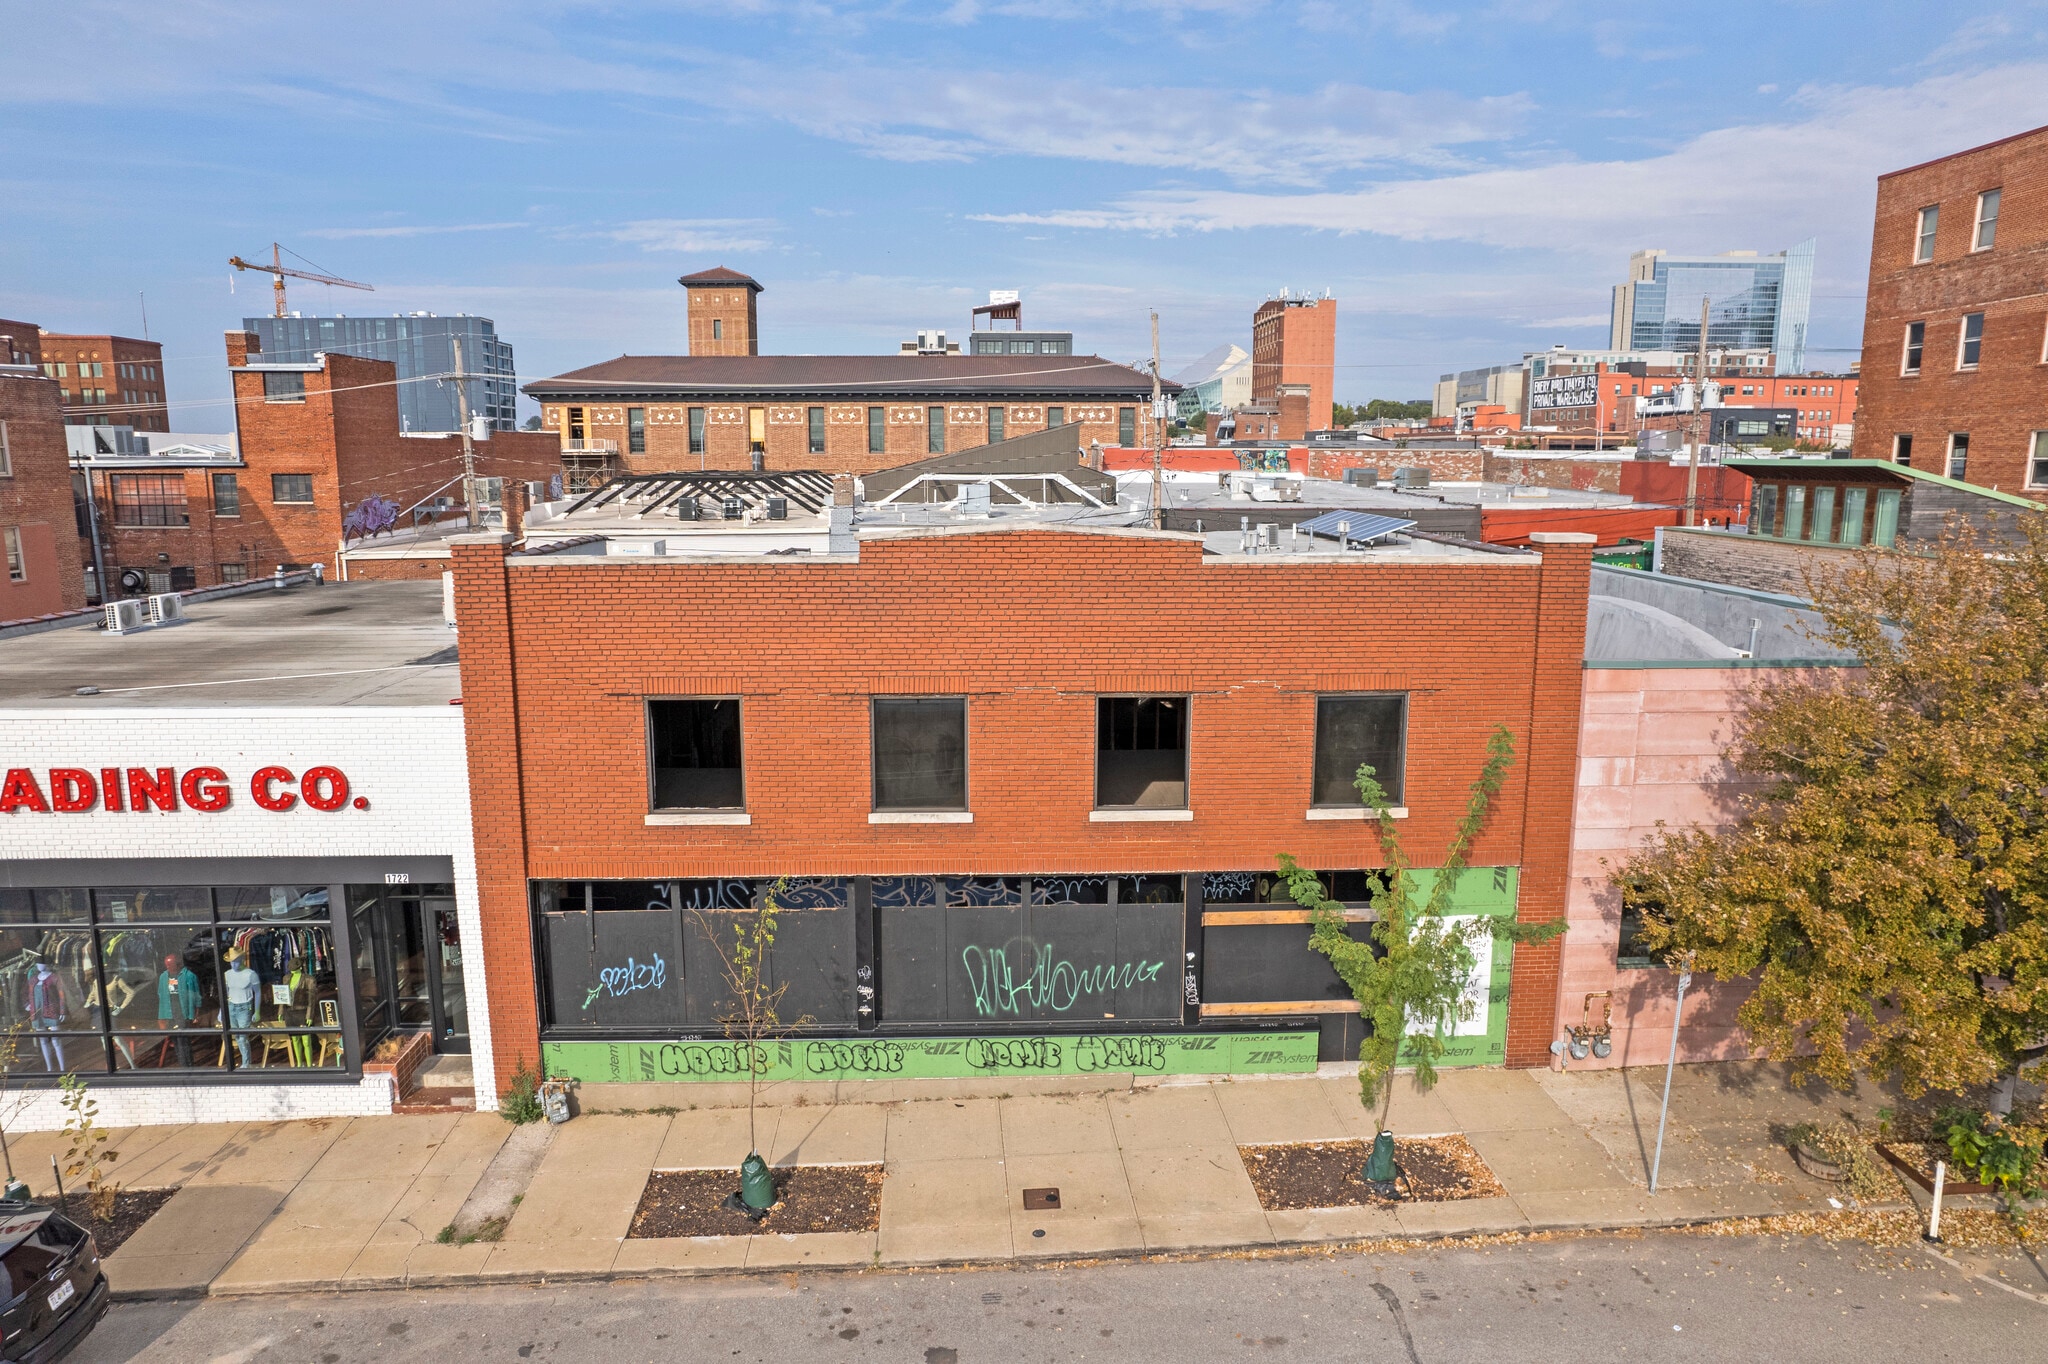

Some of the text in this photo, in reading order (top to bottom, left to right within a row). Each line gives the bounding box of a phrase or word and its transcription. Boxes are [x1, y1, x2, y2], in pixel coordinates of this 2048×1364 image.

[0, 765, 370, 813] ADING CO.
[387, 874, 408, 883] 1722
[324, 1001, 334, 1025] OPEN
